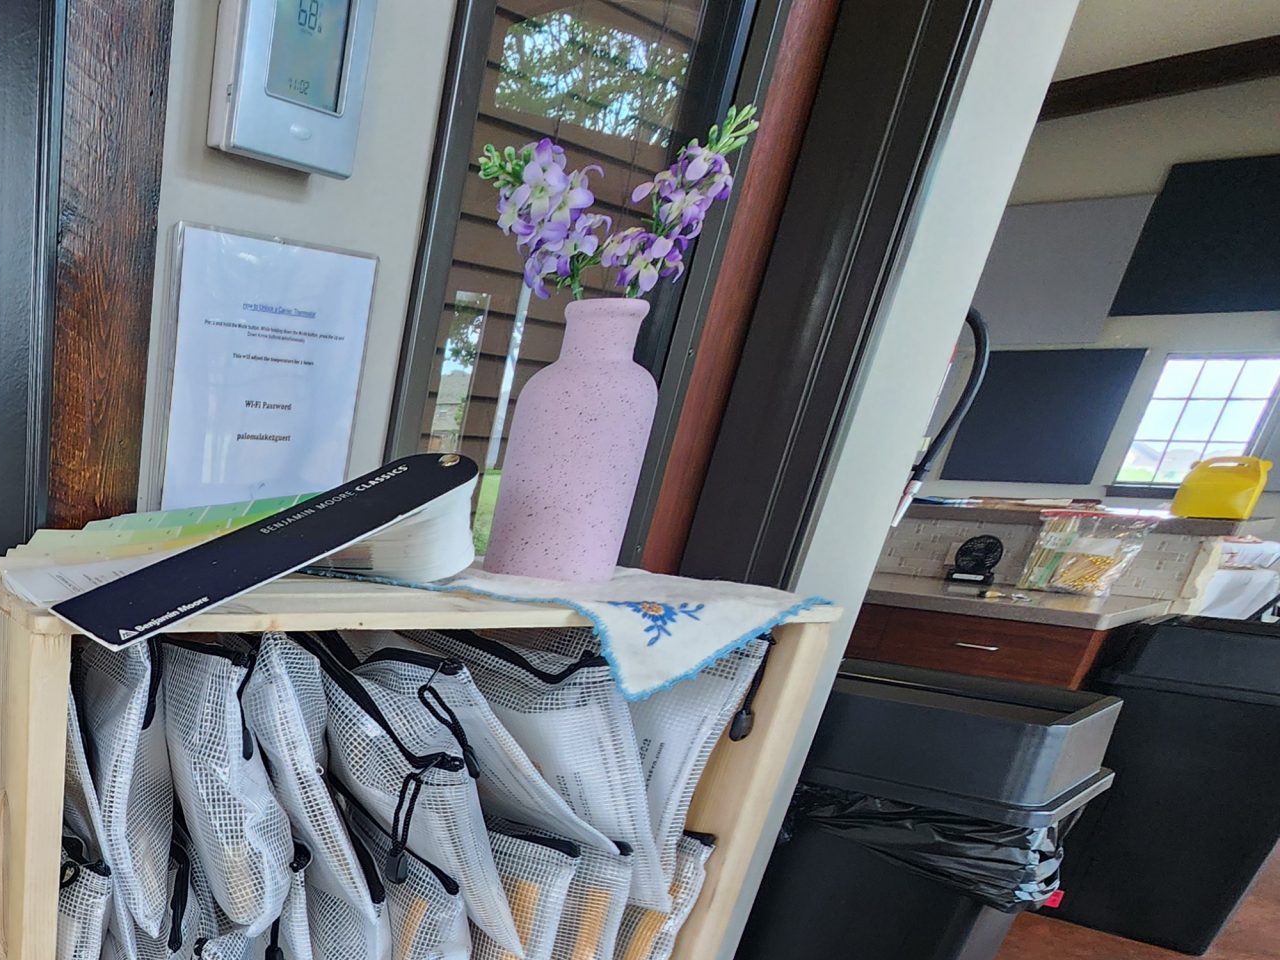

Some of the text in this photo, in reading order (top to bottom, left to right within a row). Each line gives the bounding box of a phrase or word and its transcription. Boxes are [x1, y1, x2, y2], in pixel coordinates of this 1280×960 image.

[262, 402, 292, 411] Password
[260, 464, 408, 534] BENJAMIN MOORE CLASSICS
[134, 596, 209, 632] Benjamin Moore
